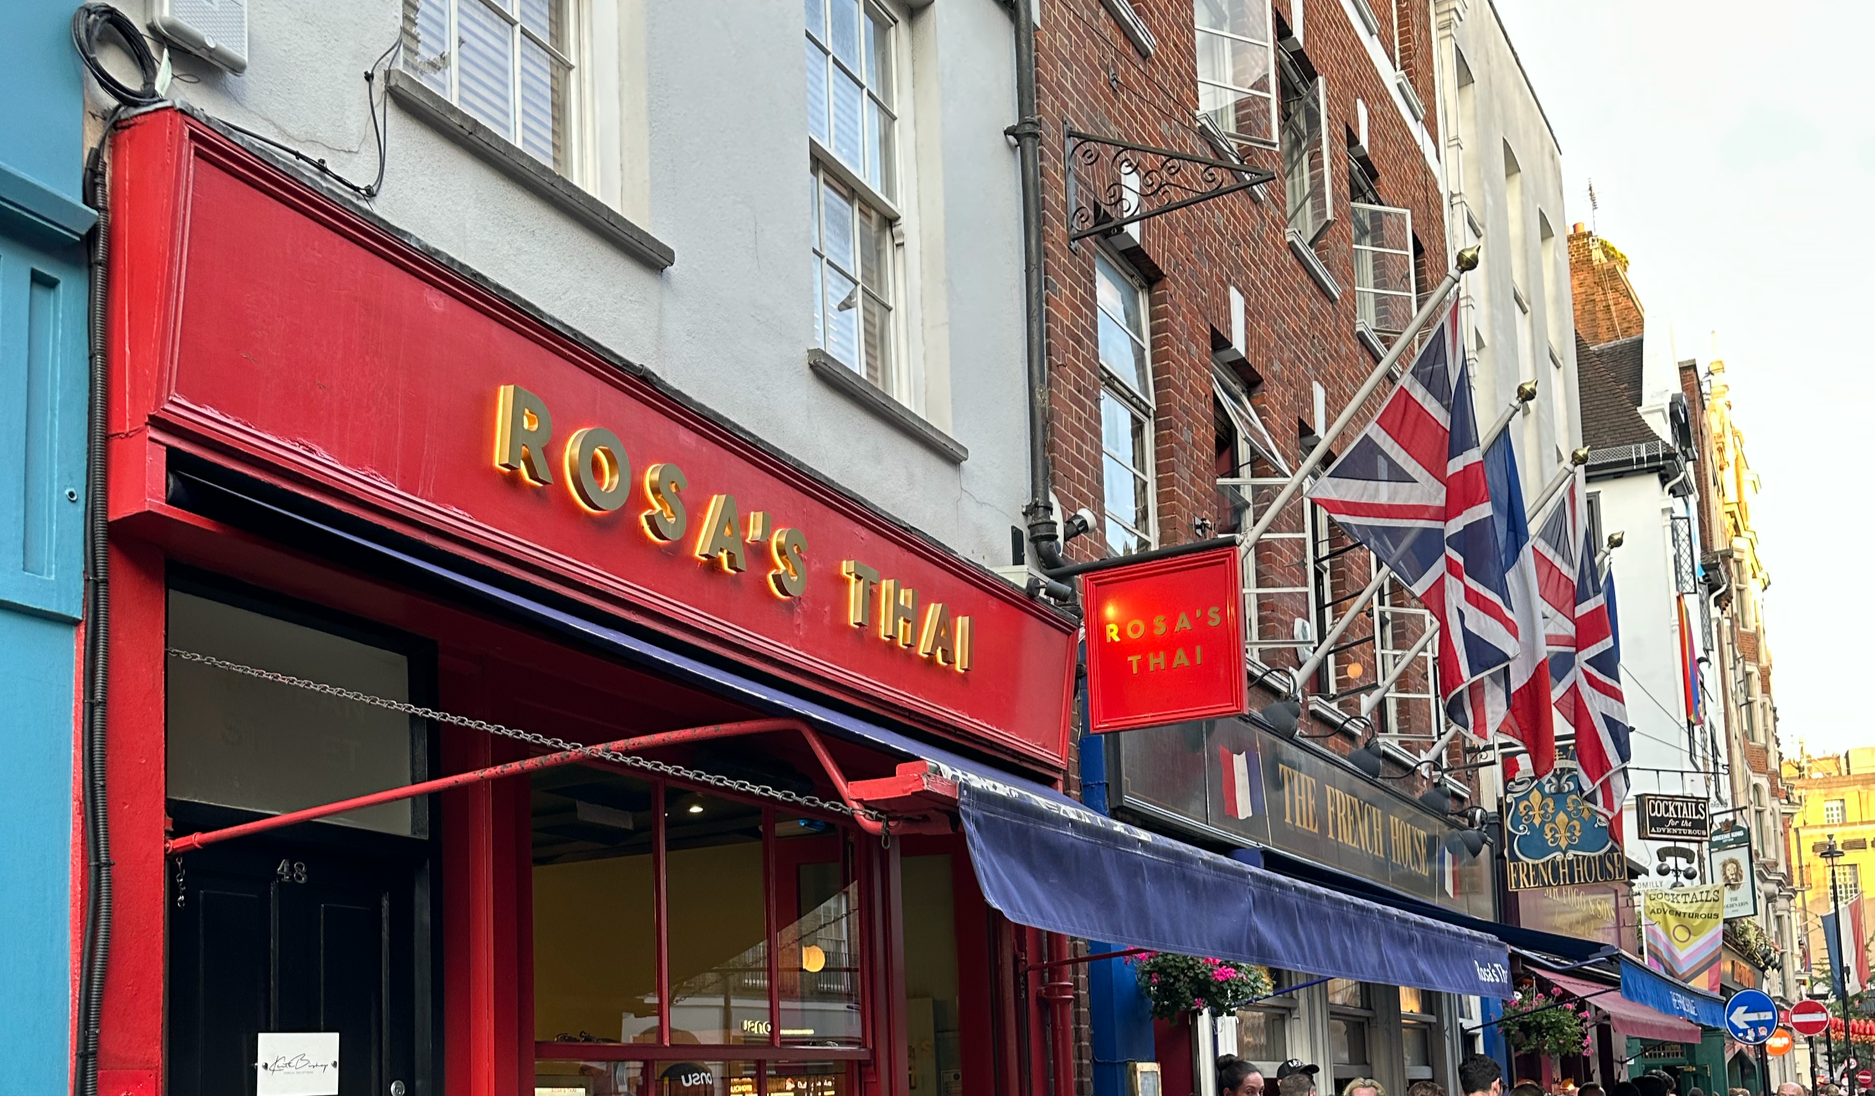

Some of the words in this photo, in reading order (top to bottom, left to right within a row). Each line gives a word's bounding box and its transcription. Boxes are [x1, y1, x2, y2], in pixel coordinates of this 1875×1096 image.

[495, 384, 808, 598] ROSA'S
[840, 559, 975, 673] THAI
[1105, 606, 1222, 643] ROSA'S
[1127, 645, 1203, 675] THAI
[1278, 763, 1319, 834] THE
[1324, 784, 1384, 860] FRENCH
[1389, 815, 1429, 877] HOUSE
[1649, 800, 1705, 820] COCKTAILS
[1650, 827, 1707, 836] ADVENTUROUS
[1665, 818, 1680, 827] for
[1681, 819, 1692, 827] the
[276, 858, 307, 884] 48
[1509, 857, 1571, 889] FRENCH
[1573, 851, 1625, 883] HOUSE
[1634, 880, 1663, 889] OMILLY
[1649, 889, 1720, 904] COCKTAILS
[1649, 907, 1719, 919] ADVENTUROUS
